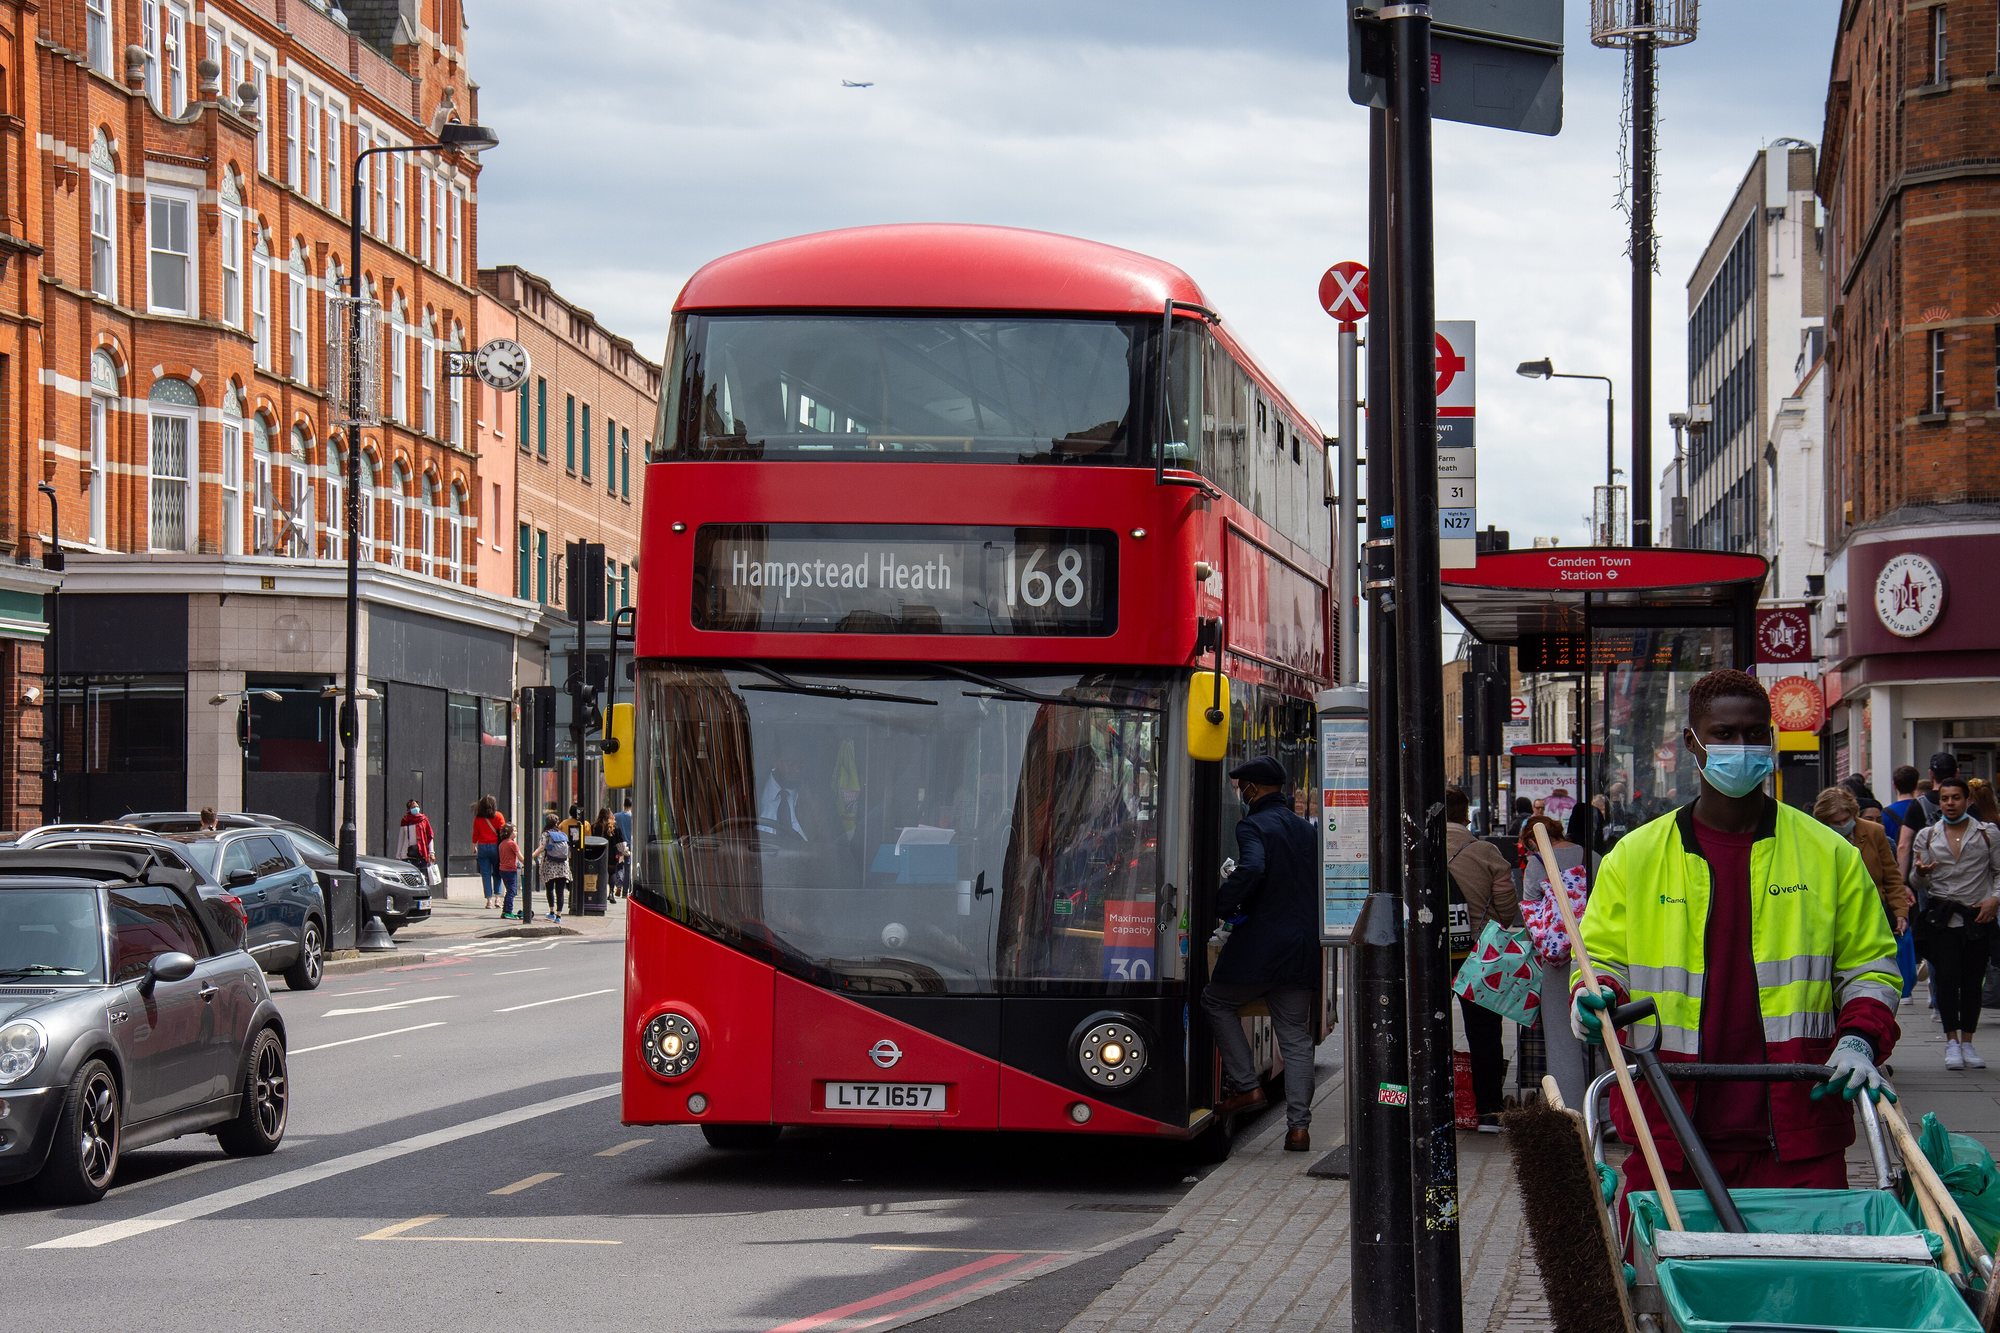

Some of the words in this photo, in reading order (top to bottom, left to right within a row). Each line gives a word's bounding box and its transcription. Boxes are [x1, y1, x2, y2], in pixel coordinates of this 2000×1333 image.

[1328, 270, 1367, 312] X
[1451, 487, 1464, 498] 31
[1444, 518, 1470, 528] N27
[1548, 557, 1596, 567] Camden
[1600, 556, 1631, 567] Town
[732, 550, 869, 598] Hampstead
[880, 552, 951, 590] Heath
[1007, 548, 1084, 608] 168
[1561, 570, 1602, 580] Station
[1879, 558, 1908, 593] ORGANIC
[1912, 559, 1937, 589] COFFEE
[1893, 581, 1924, 610] PRET
[1758, 611, 1783, 635] ORGANIC
[1785, 612, 1807, 632] COFFEE
[1881, 608, 1917, 632] NATURAL
[1919, 603, 1936, 626] FOOD
[1760, 642, 1790, 658] NATURAL
[1791, 640, 1806, 655] FOOD
[1520, 776, 1554, 785] Immune
[1556, 776, 1587, 786] Syste
[1781, 883, 1809, 894] VEOLIA
[1109, 913, 1156, 924] Maximum
[1112, 925, 1152, 936] capacity
[1110, 958, 1151, 980] 30
[839, 1086, 880, 1106] LTZ
[886, 1086, 933, 1107] 1657
